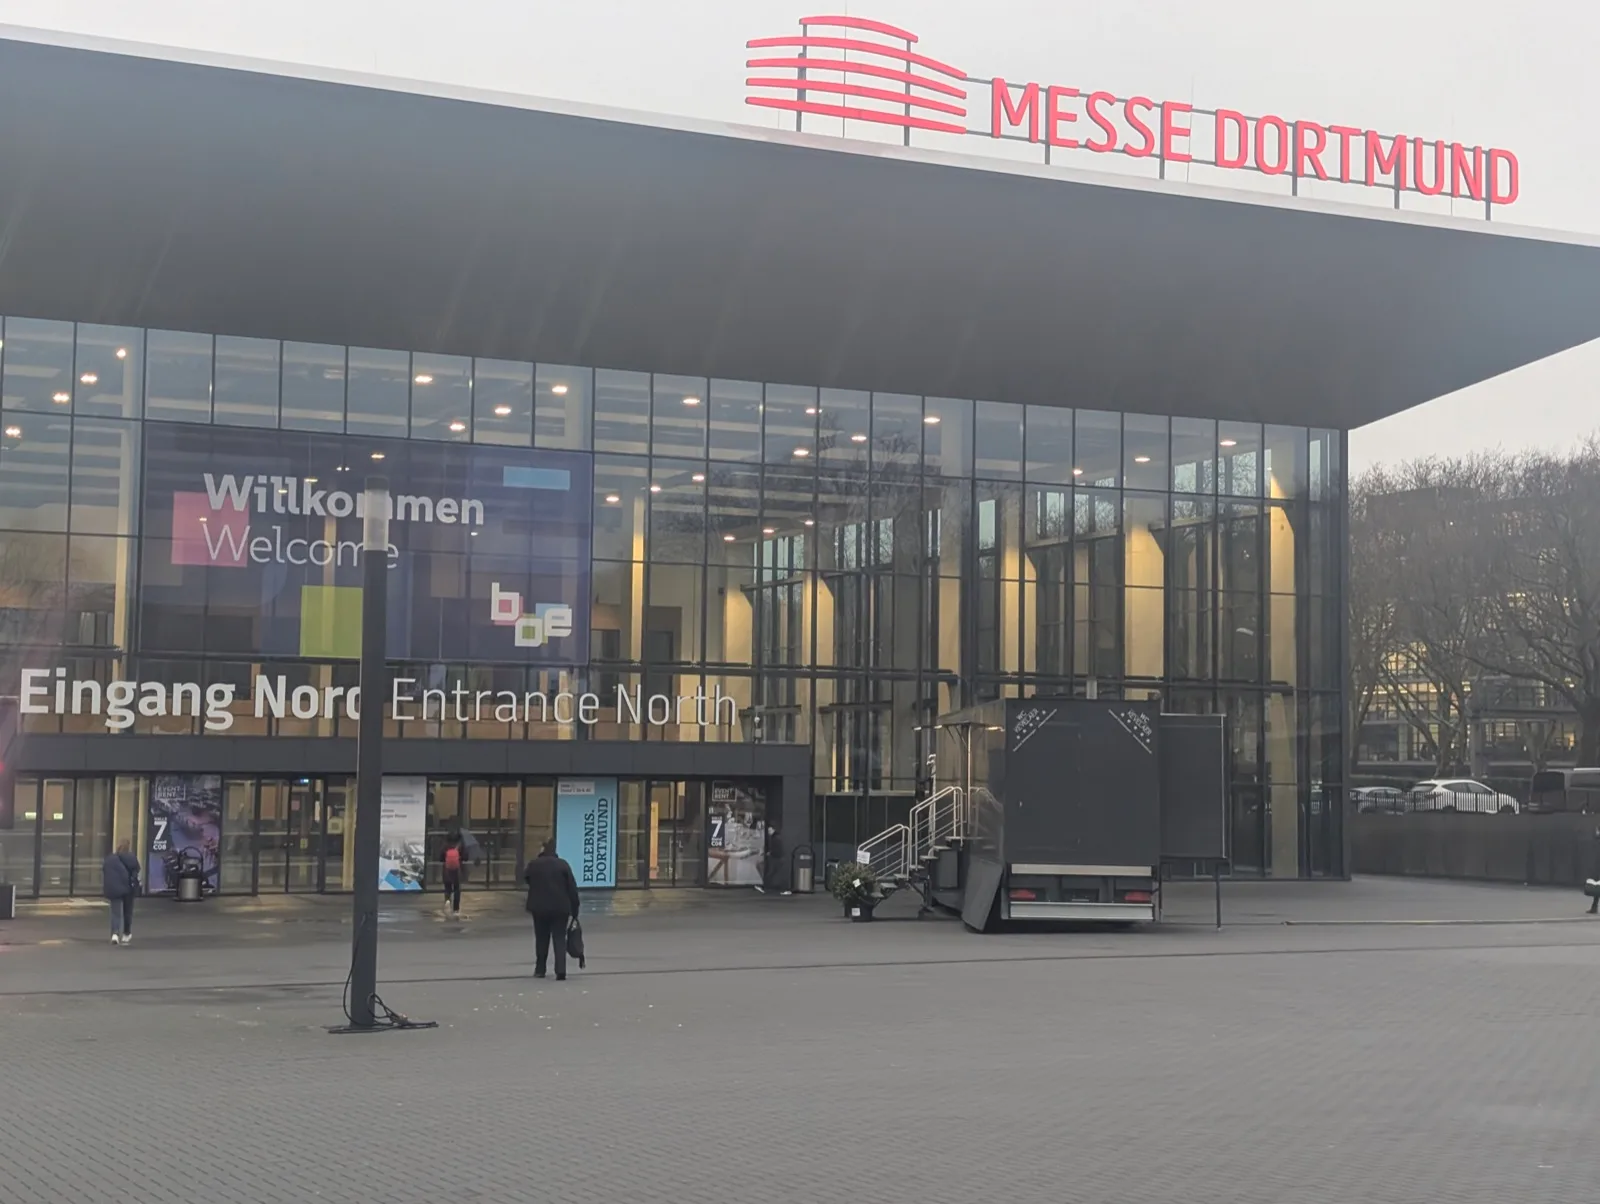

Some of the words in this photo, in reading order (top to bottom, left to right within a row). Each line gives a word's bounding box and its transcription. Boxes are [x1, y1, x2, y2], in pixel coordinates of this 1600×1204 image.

[991, 77, 1193, 163] MESSE
[1214, 108, 1519, 205] DORTMUND
[19, 667, 236, 731] Eingang
[391, 677, 600, 725] Entrance
[616, 683, 737, 727] North
[154, 820, 167, 841] 7
[583, 809, 595, 882] ERLEBNIS.
[596, 798, 608, 882] DORTMUND
[711, 820, 722, 838] 7
